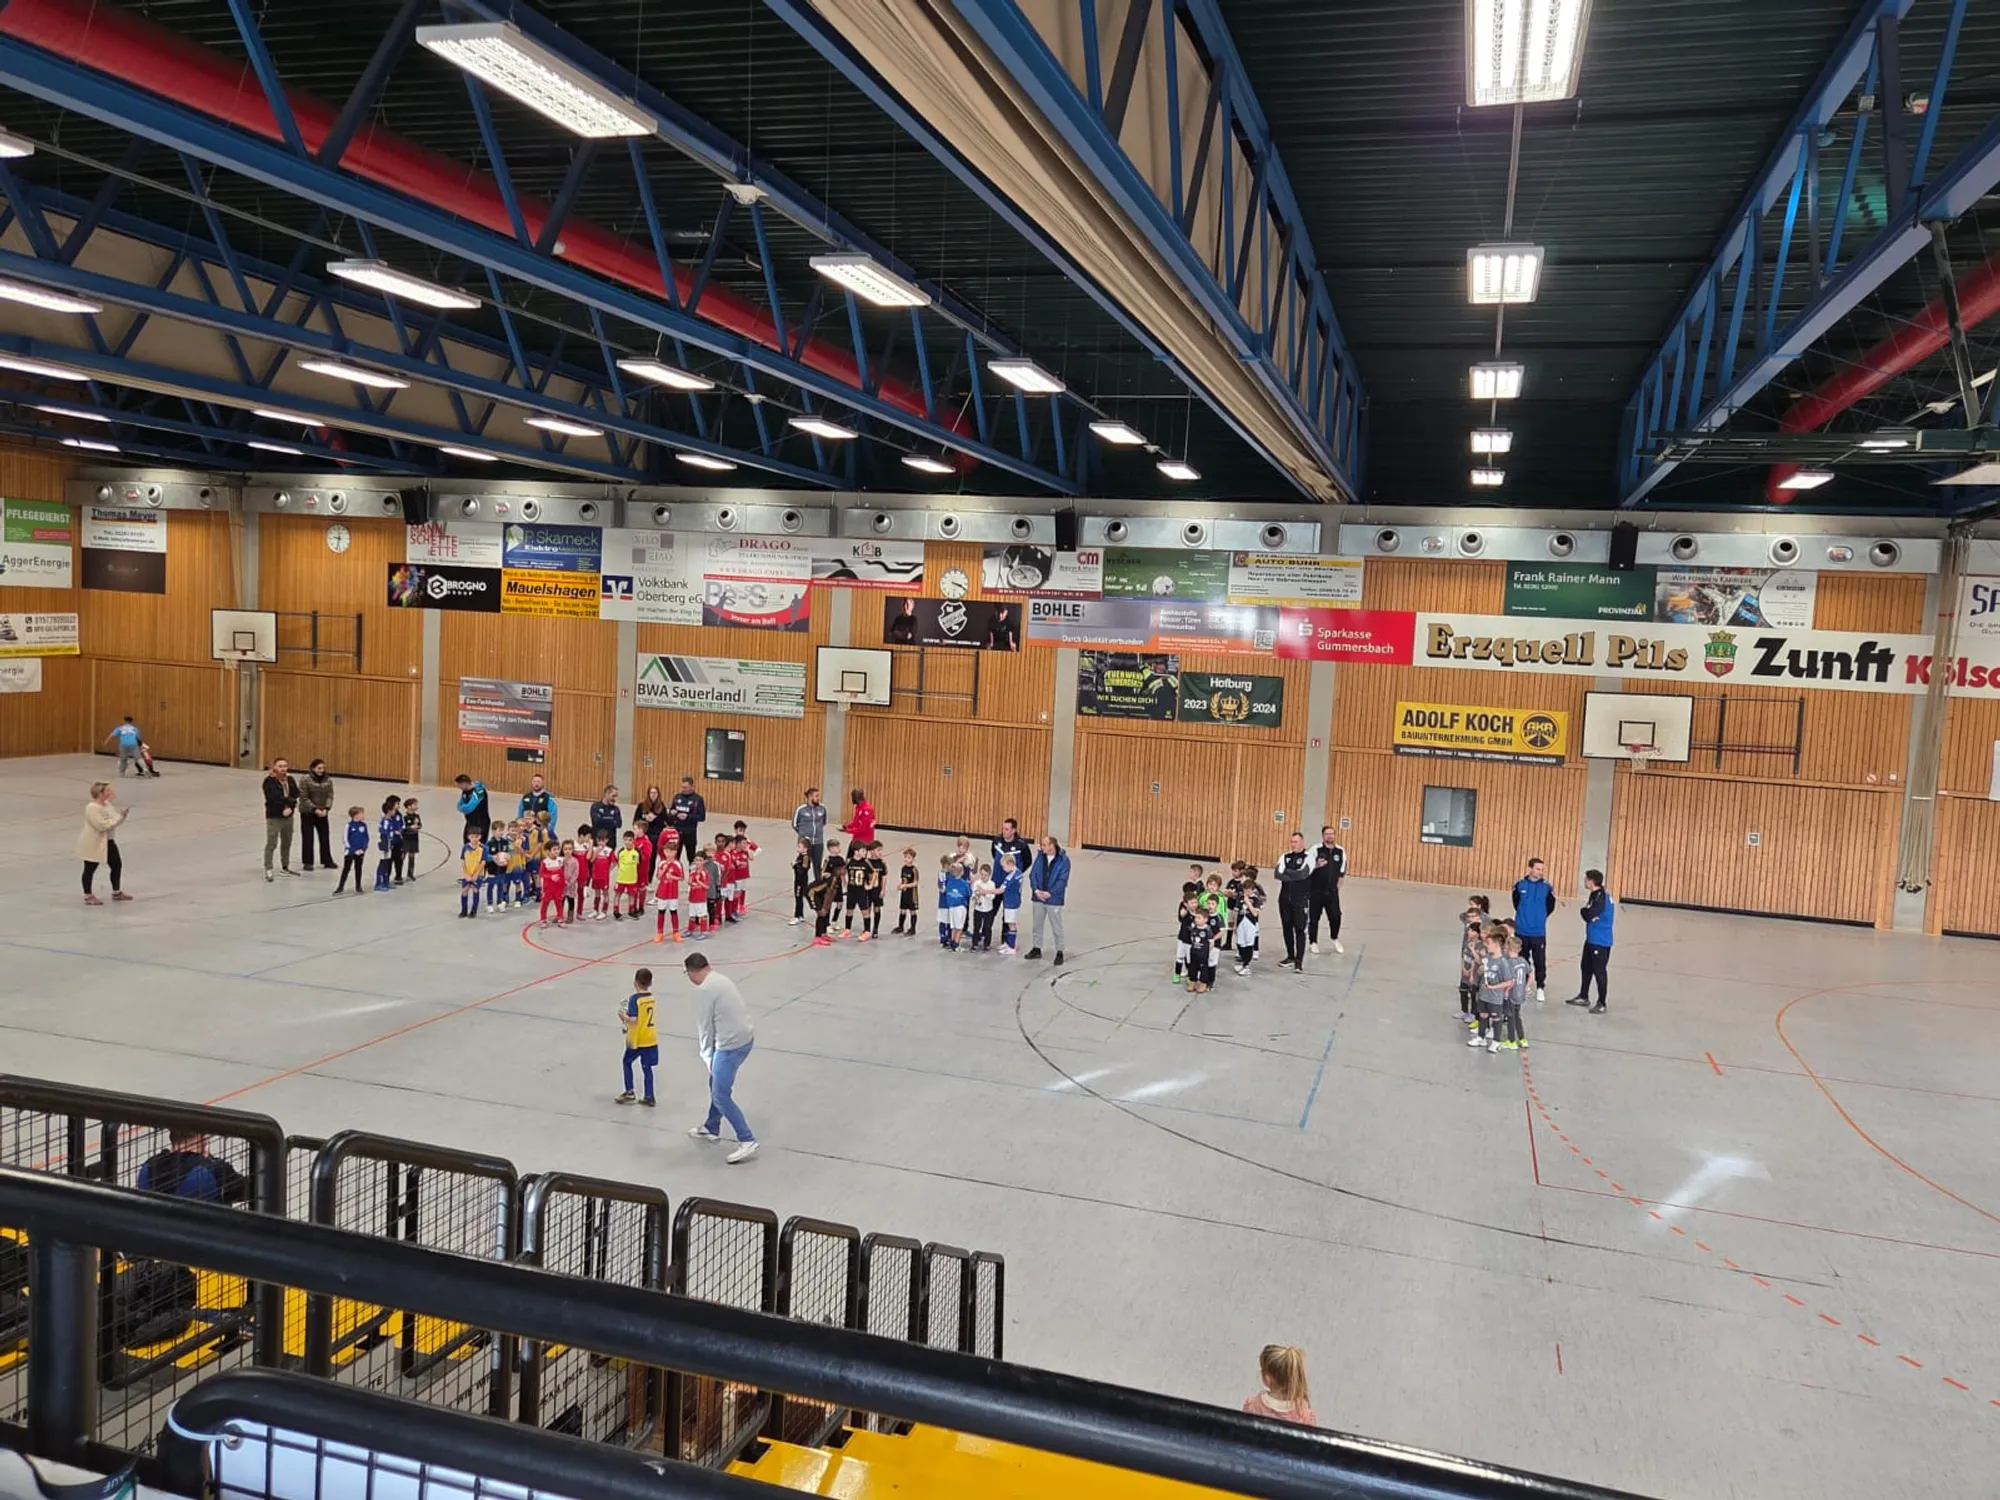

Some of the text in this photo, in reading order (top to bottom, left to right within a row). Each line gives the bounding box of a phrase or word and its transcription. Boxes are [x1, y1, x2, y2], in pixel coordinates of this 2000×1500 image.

[6, 508, 71, 524] PFLEGEDIENST
[91, 508, 157, 521] Thomas Meyer
[739, 538, 791, 551] DRAGO
[2, 554, 70, 570] AggerEnergie
[638, 577, 688, 589] Volksbank
[1513, 571, 1620, 585] Frank Rainer Mann
[447, 581, 487, 591] BROGNO
[506, 581, 596, 600] Mauelshagen
[636, 590, 686, 606] Oberberg
[688, 593, 703, 604] eG
[1032, 602, 1081, 617] BOHLE
[1598, 606, 1643, 615] PROVINZIAL
[1318, 627, 1372, 640] Sparkasse
[1317, 641, 1394, 654] Gummersbach
[1425, 622, 1595, 668] Erzquell
[1605, 633, 1689, 672] Pils
[1750, 637, 1896, 683] Zunft
[521, 687, 547, 697] BOHLE
[1210, 677, 1252, 692] Hofburg
[637, 683, 742, 703] BWA Sauerland
[1184, 698, 1276, 714] 2023 2024
[1402, 708, 1514, 733] ADOLF KOCH
[1400, 730, 1513, 747] BAUUNTERNEHMUNG GMBH
[646, 1007, 655, 1028] 2
